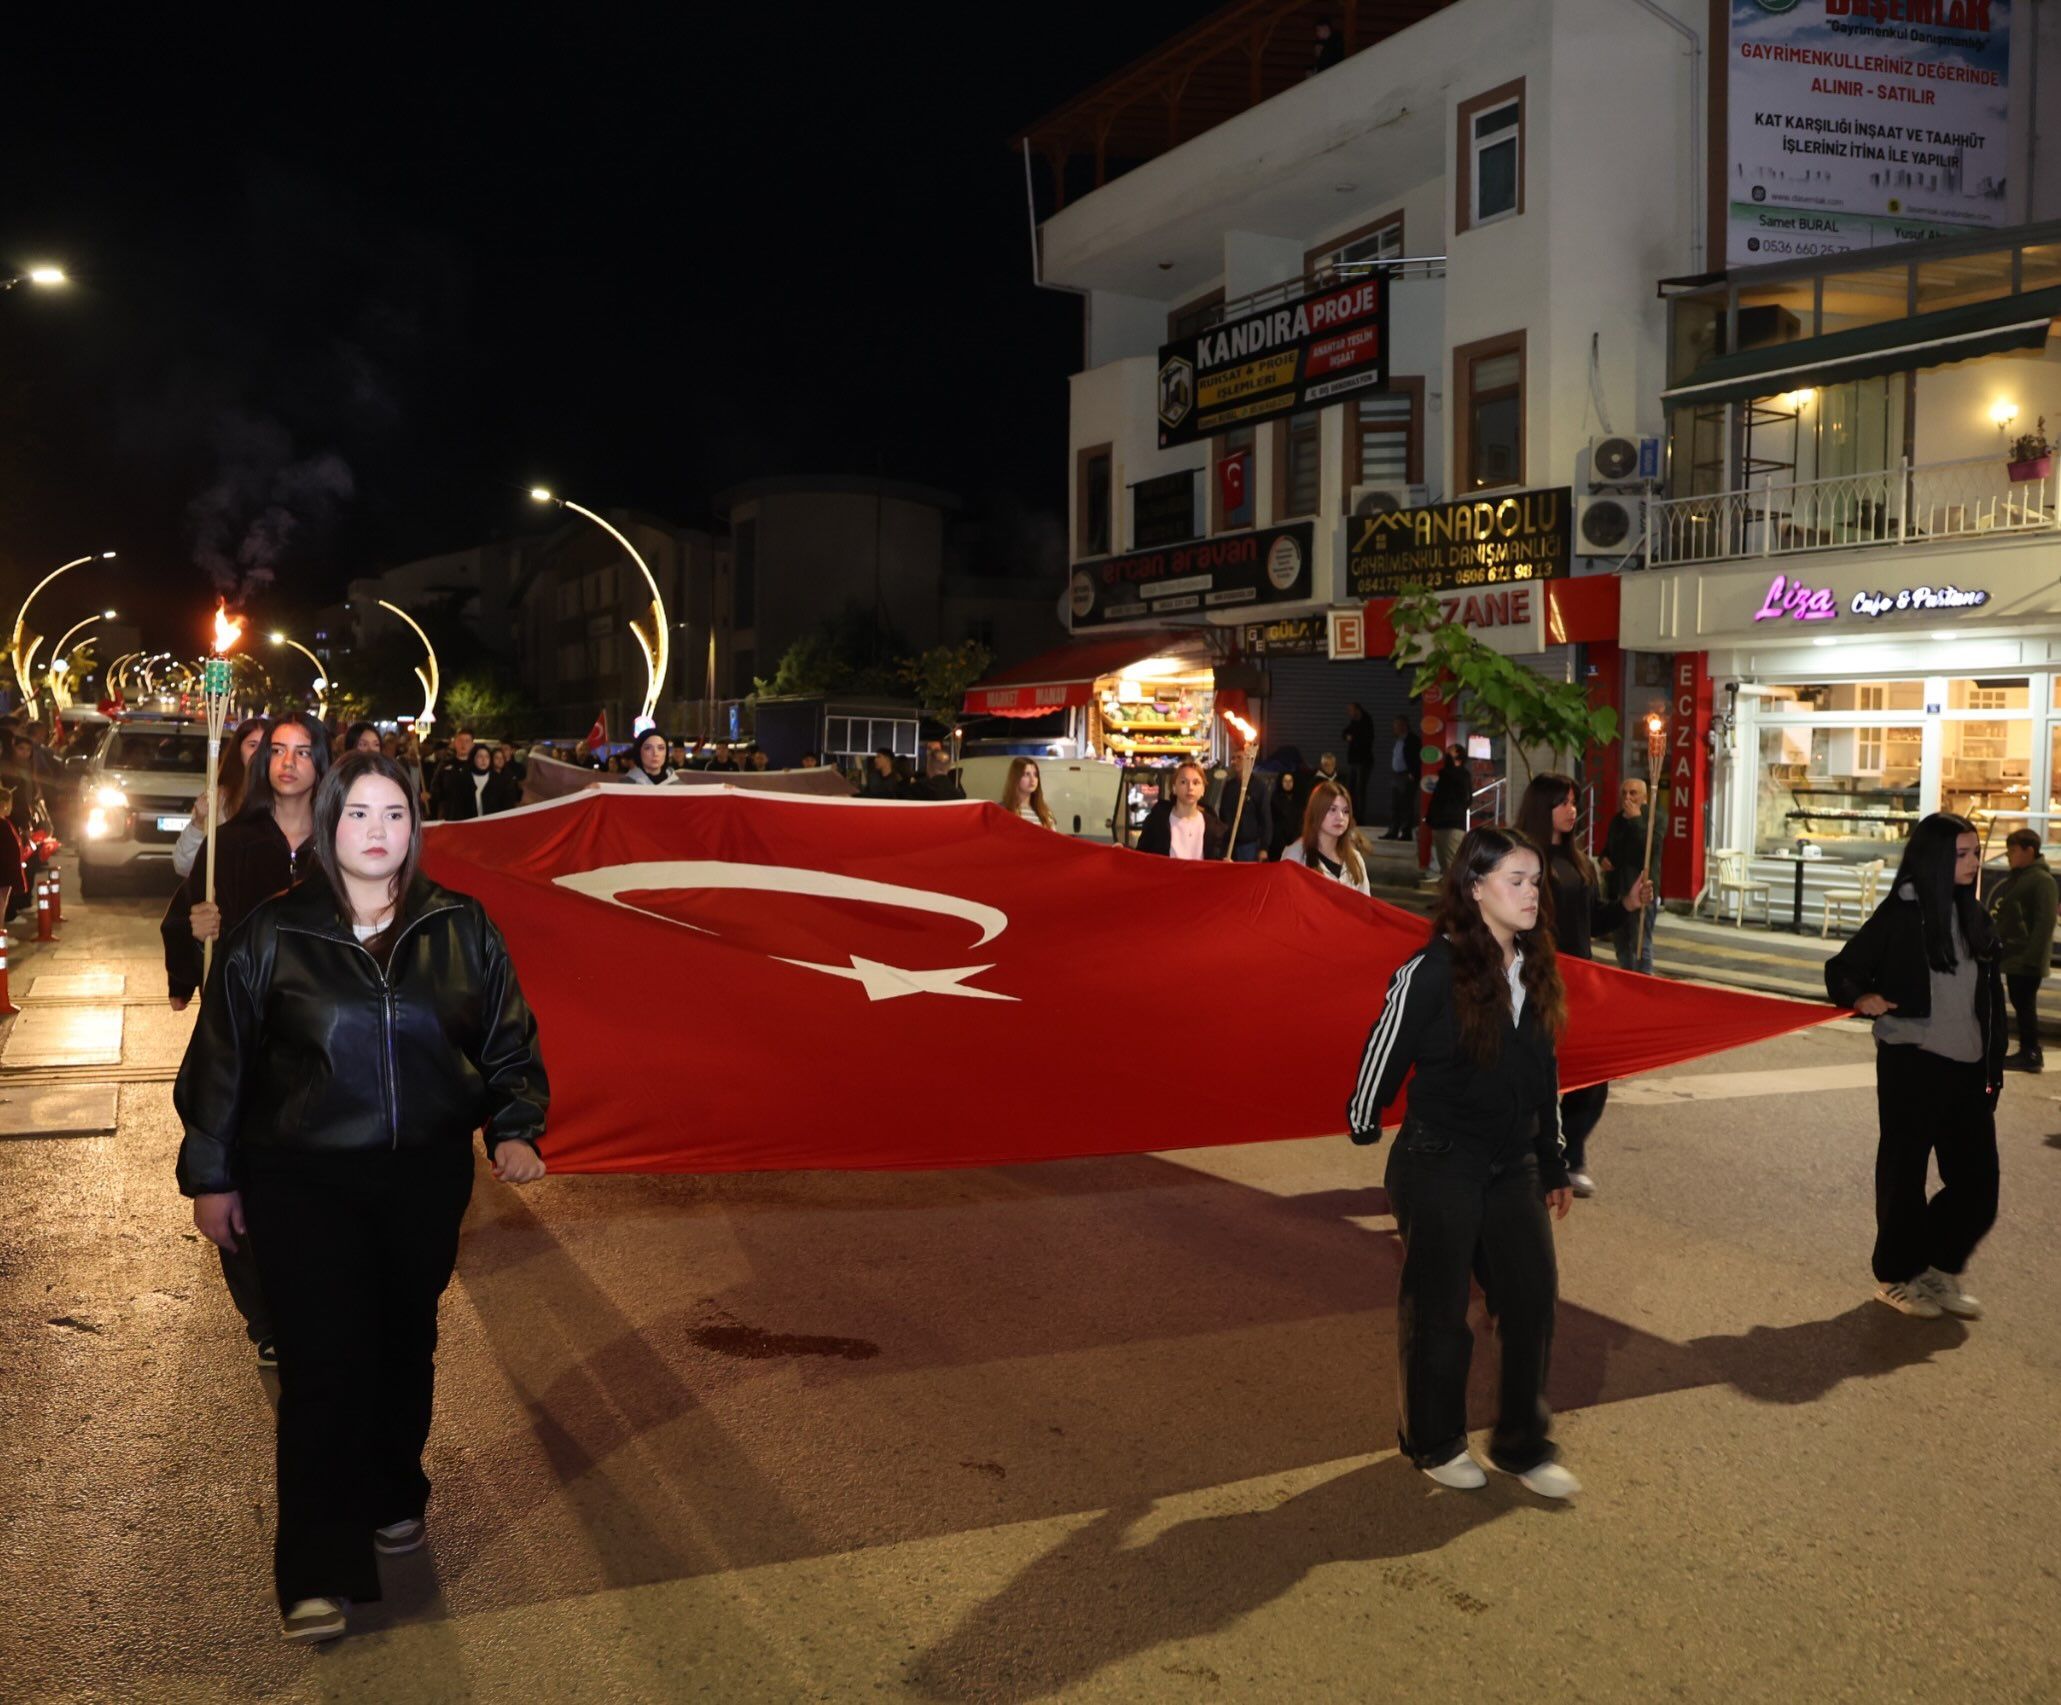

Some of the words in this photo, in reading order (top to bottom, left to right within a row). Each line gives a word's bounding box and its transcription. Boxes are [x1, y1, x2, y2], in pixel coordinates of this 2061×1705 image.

[1741, 43, 1913, 76] GAYRİMENKULLERİNİZ
[1917, 61, 1999, 87] DEĞERİNDE
[1811, 78, 1863, 97] ALINIR
[1877, 84, 1935, 105] SATILIR
[1755, 112, 1782, 127] KAT
[1785, 115, 1851, 135] KARŞILIĞI
[1854, 119, 1903, 139] İNŞAAT
[1906, 128, 1923, 142] VE
[1926, 130, 1985, 150] TAAHHÜT
[1783, 135, 1847, 157] İŞLERİNİZ
[1850, 141, 1885, 160] İTİNA
[1888, 146, 1908, 163] İLE
[1912, 151, 1959, 168] YAPILIR
[1759, 214, 1795, 230] Samet
[1799, 218, 1839, 233] BURAL
[1894, 226, 1924, 240] Yusuf
[1762, 239, 1793, 254] 0536
[1796, 243, 1818, 256] 660
[1197, 305, 1311, 370] KANDIRA
[1312, 286, 1374, 328] PROJE
[1415, 493, 1557, 546] ANADOLU
[1351, 549, 1444, 576] GAYRİMENKUL
[1449, 536, 1560, 567] DANIŞMANLIĞI
[1456, 567, 1485, 584] 0506
[1488, 565, 1511, 582] 611
[1755, 575, 1837, 621] Liza
[1912, 585, 1988, 609] Pastane
[1340, 621, 1356, 649] E
[1673, 664, 1693, 838] ECZANE
